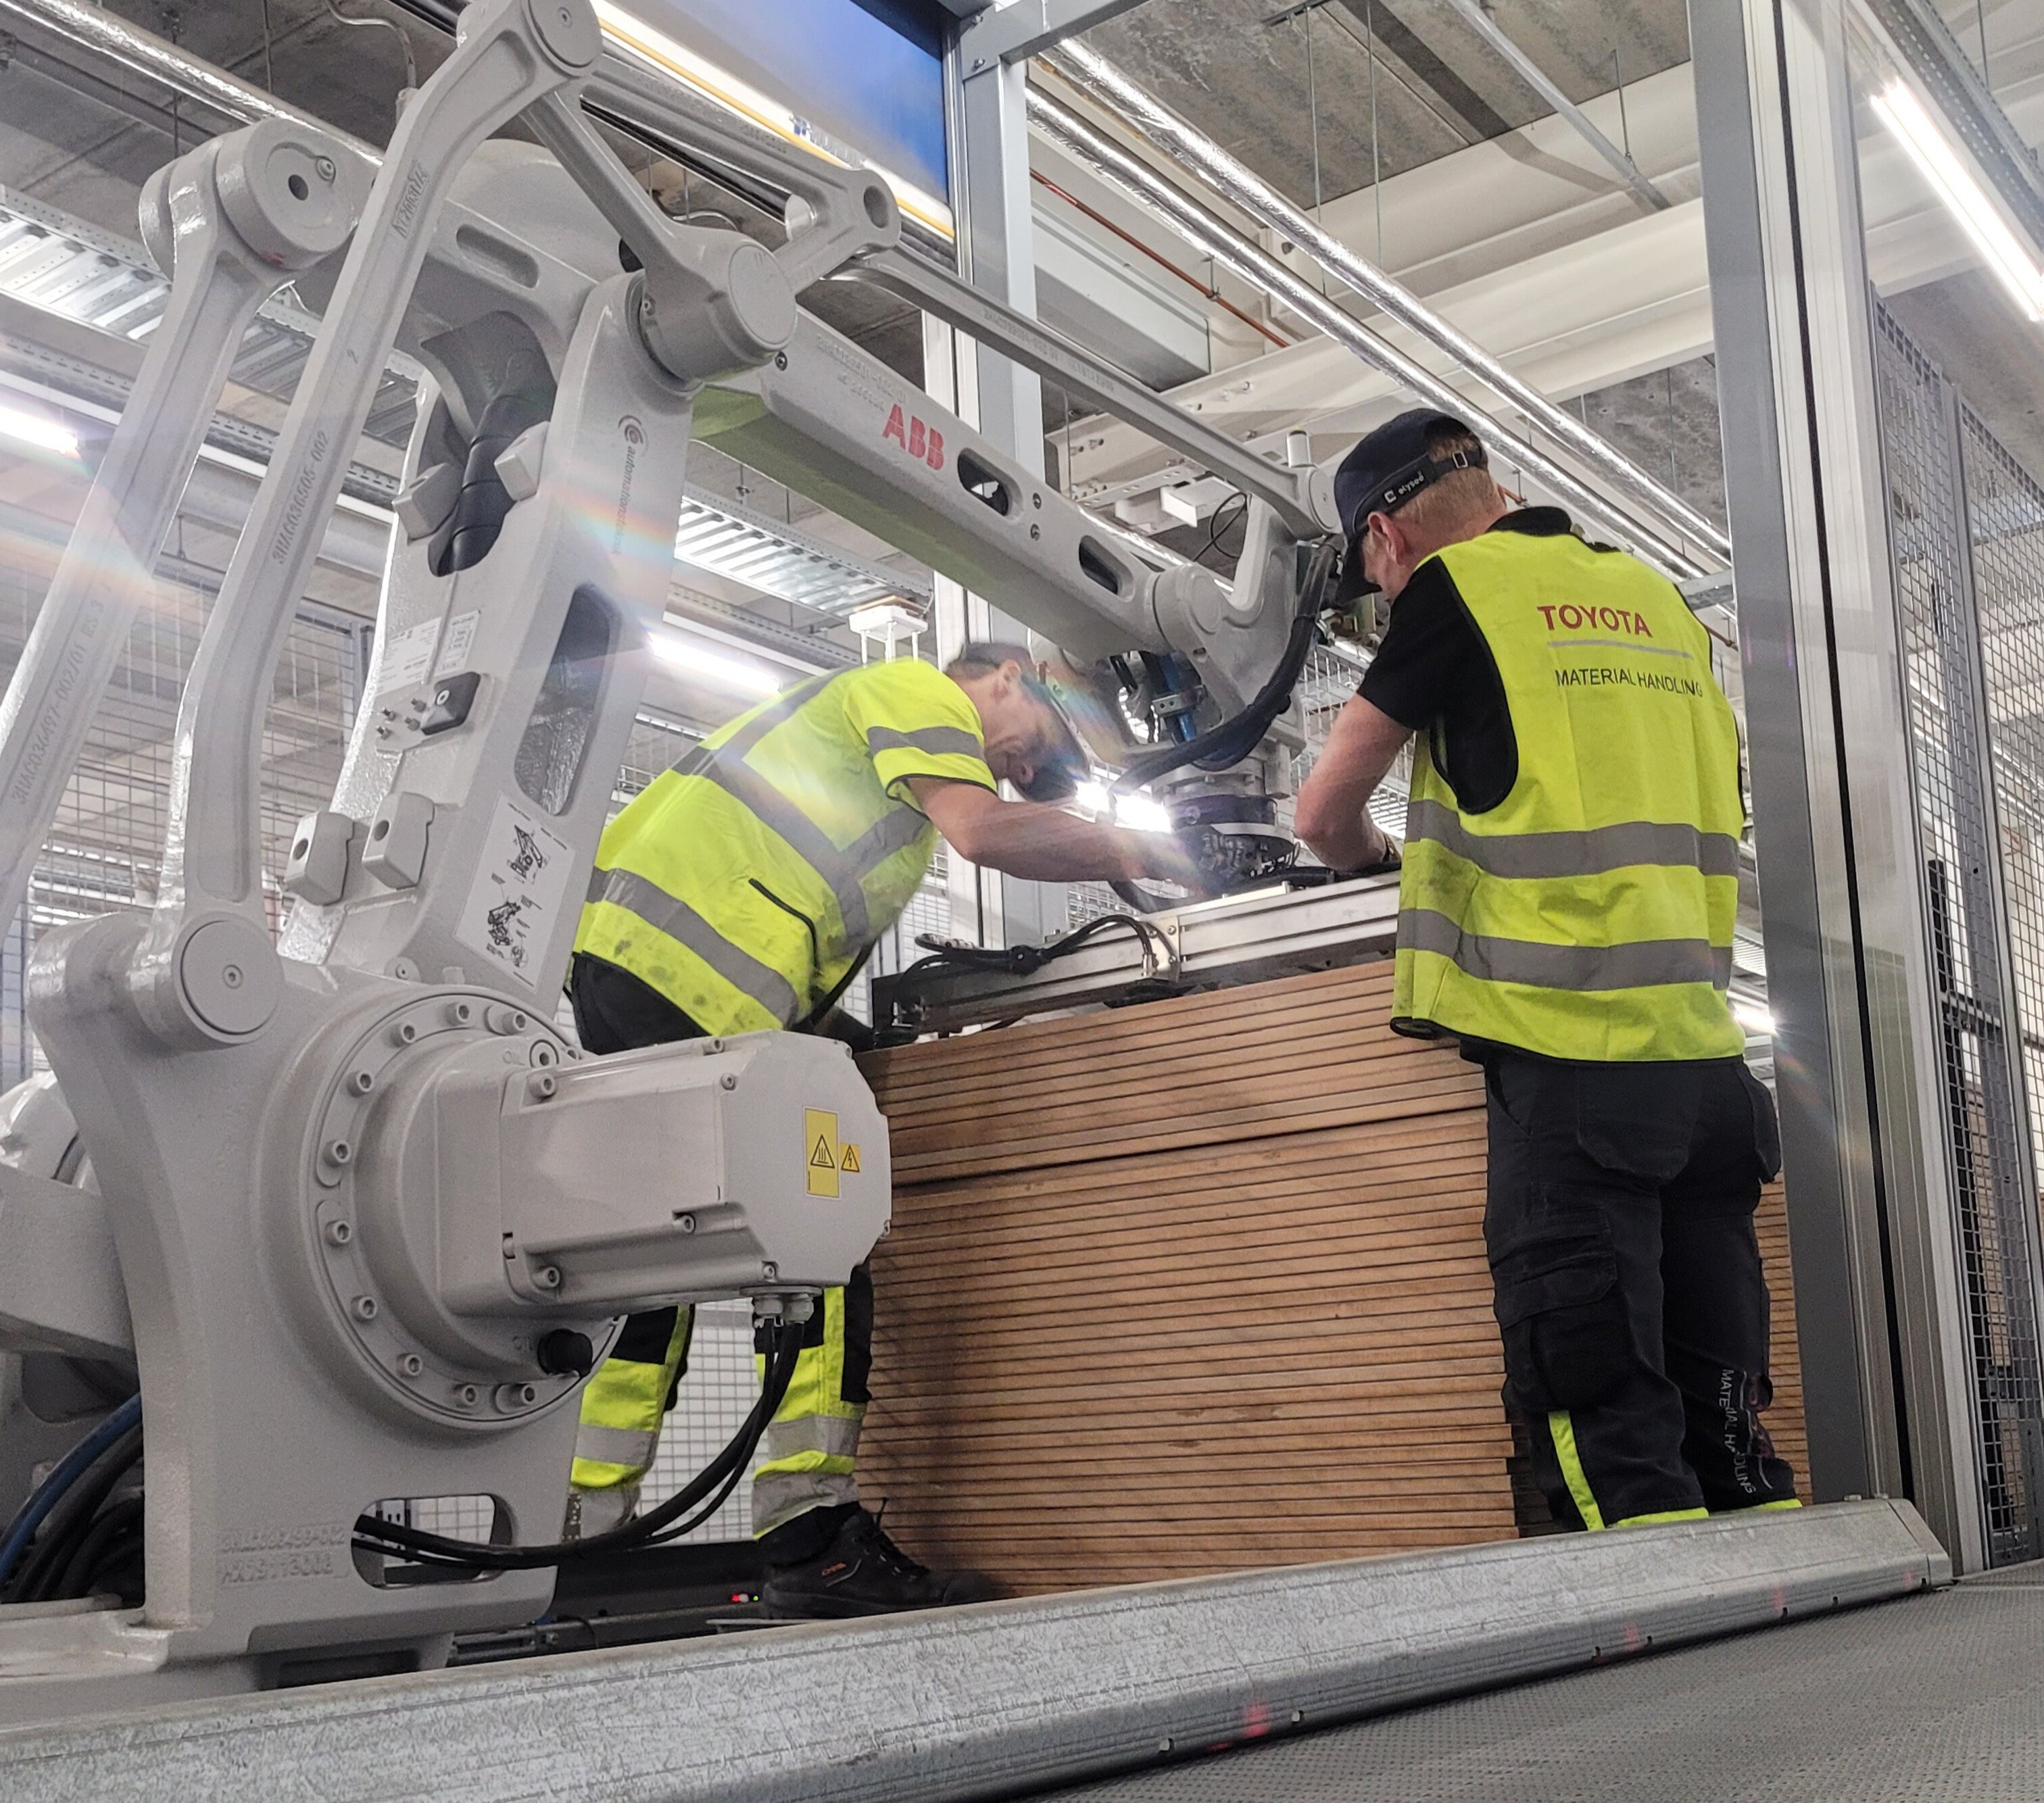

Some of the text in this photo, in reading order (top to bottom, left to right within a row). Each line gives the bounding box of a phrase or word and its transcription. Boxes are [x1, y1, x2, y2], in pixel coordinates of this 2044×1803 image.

[882, 403, 944, 470] ABB
[1537, 604, 1653, 637] TOYOTA
[1555, 668, 1703, 697] MATERIAL HANDLING
